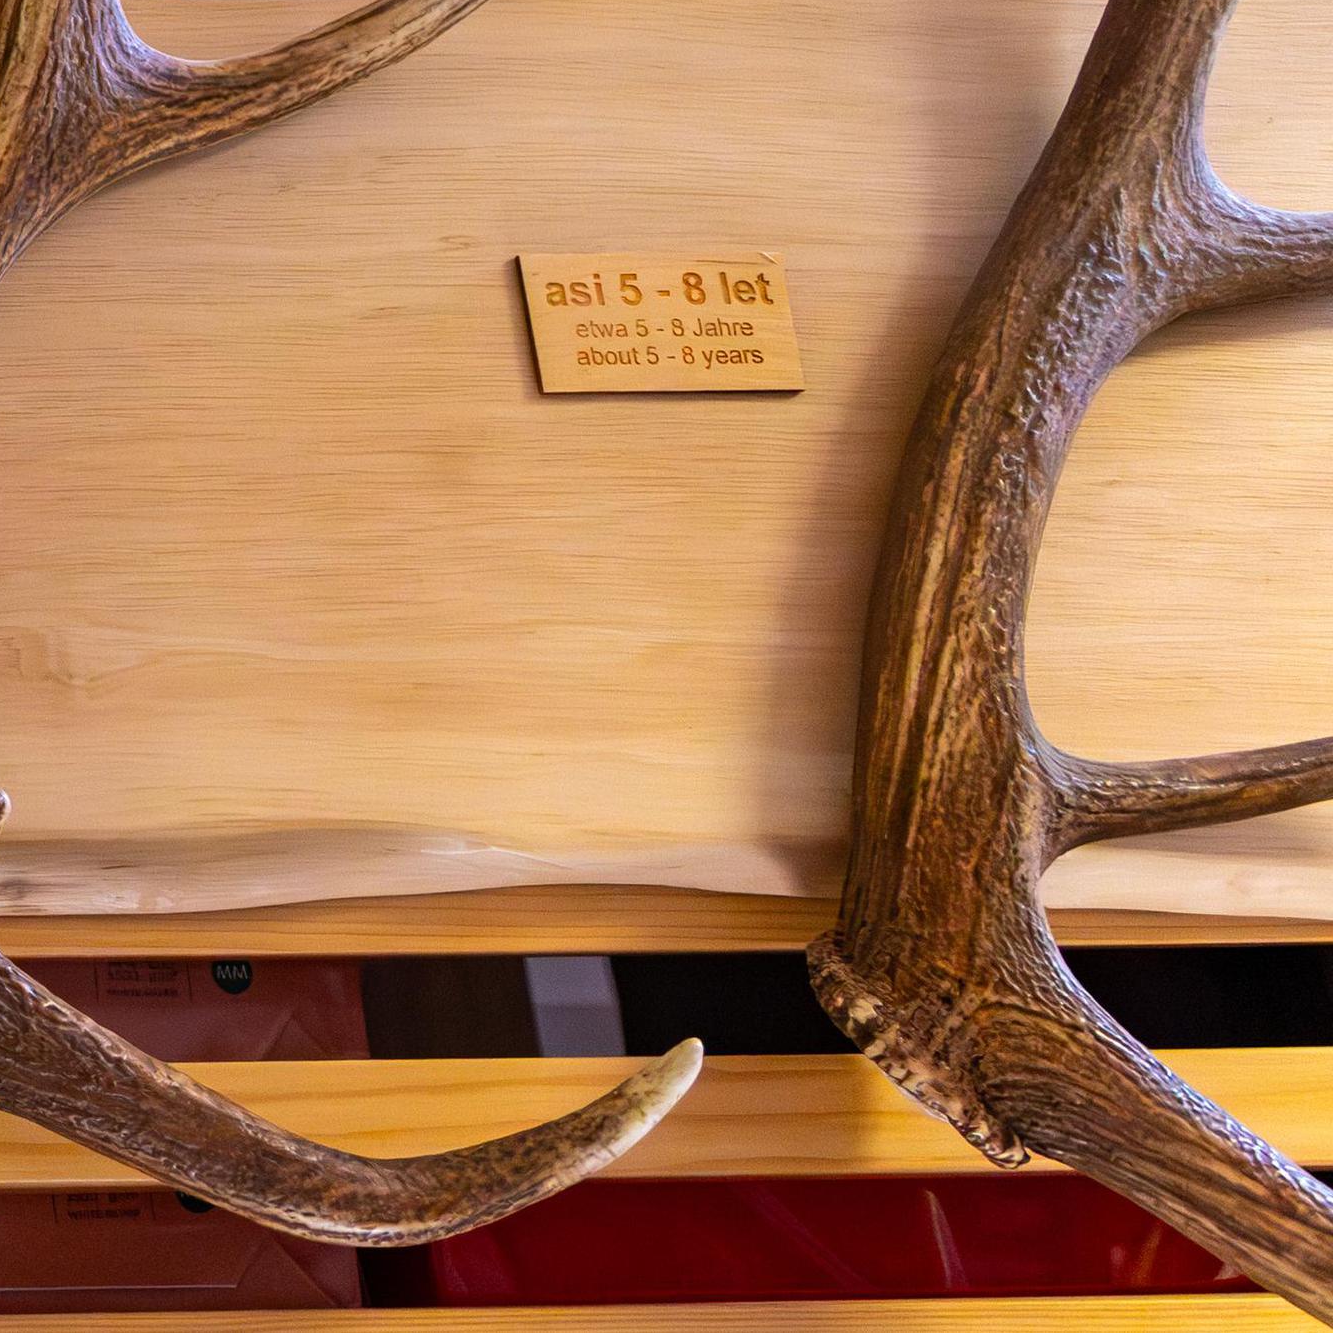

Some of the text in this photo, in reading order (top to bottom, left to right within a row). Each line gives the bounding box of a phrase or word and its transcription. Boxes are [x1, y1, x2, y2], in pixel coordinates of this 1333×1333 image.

[545, 273, 605, 307] asi
[620, 273, 643, 305] 5
[682, 272, 706, 305] 8
[718, 271, 774, 305] let
[576, 320, 629, 338] etwa
[635, 319, 649, 337] 5
[671, 318, 685, 337] 8
[692, 318, 754, 337] Jahre
[577, 347, 640, 366] about
[646, 346, 660, 365] 5
[682, 346, 695, 365] 8
[701, 347, 764, 369] years
